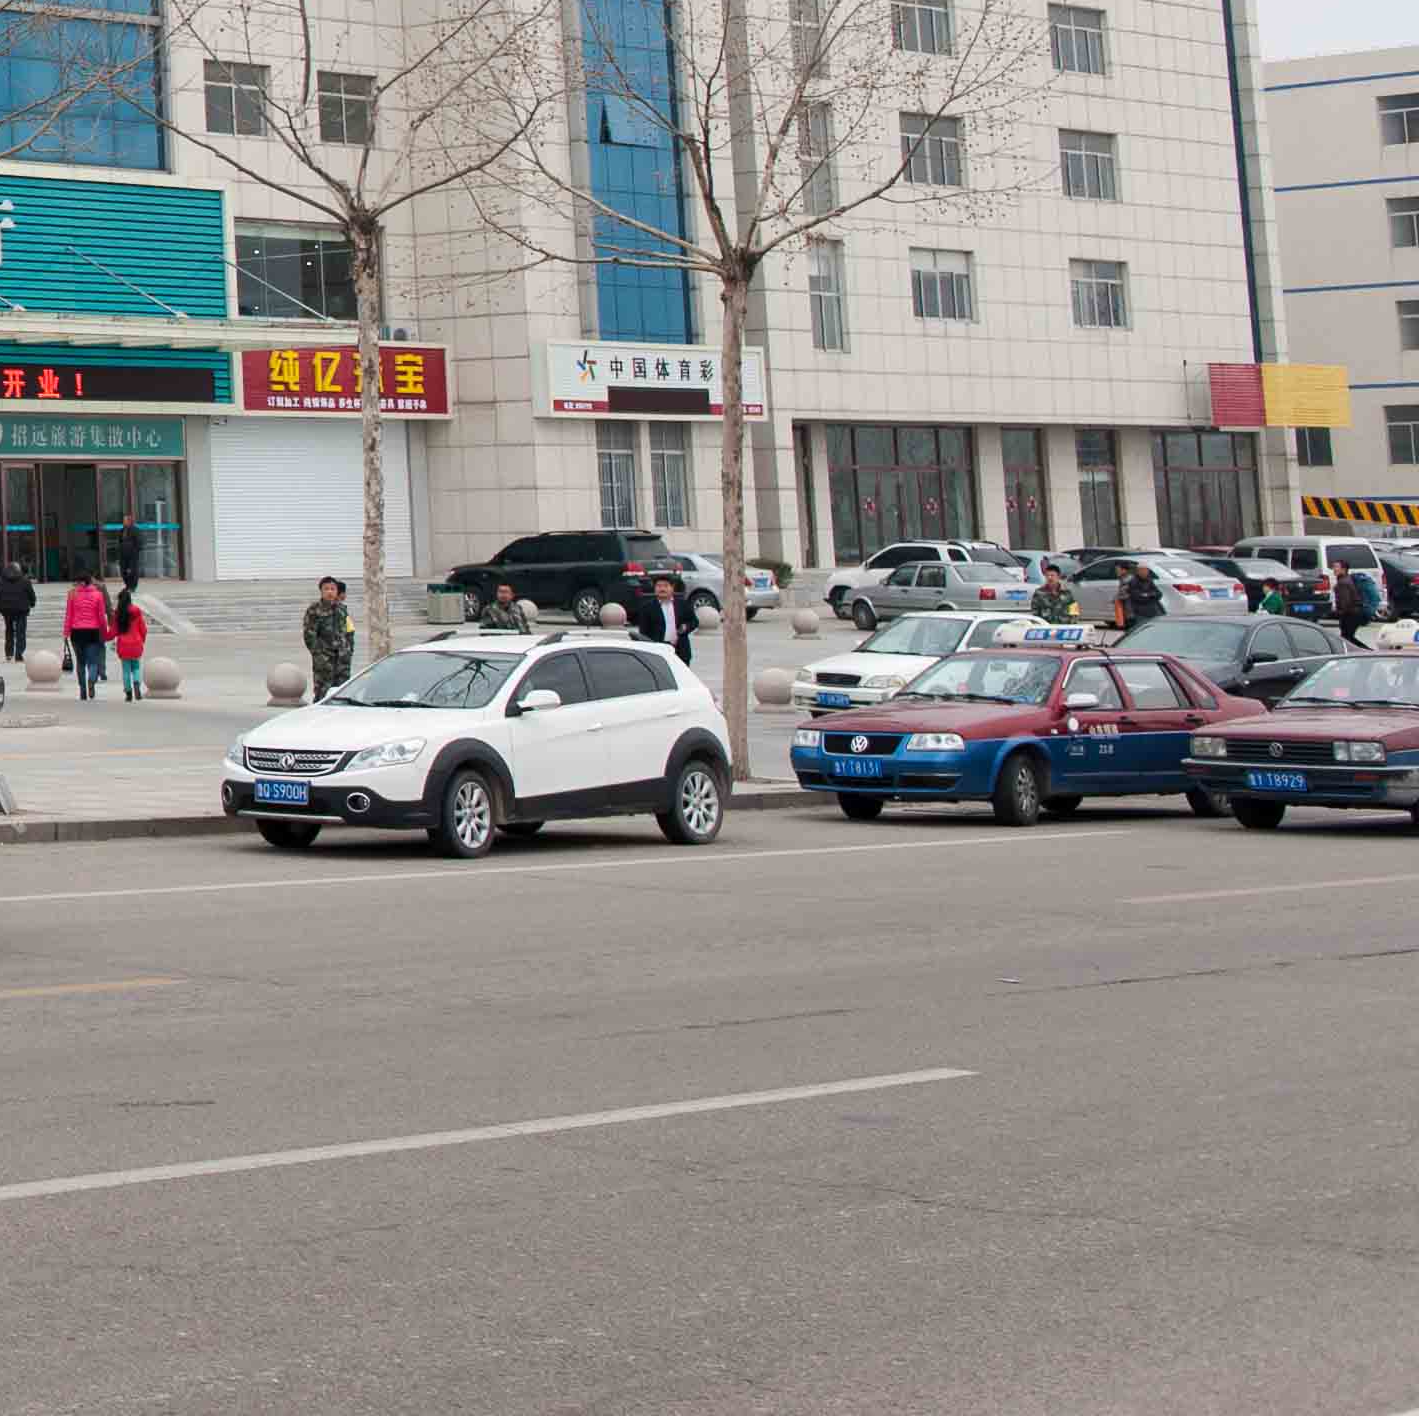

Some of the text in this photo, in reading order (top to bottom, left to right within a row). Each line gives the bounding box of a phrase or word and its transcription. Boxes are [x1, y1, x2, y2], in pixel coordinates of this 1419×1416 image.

[11, 424, 162, 449] 招远旅游集散中心
